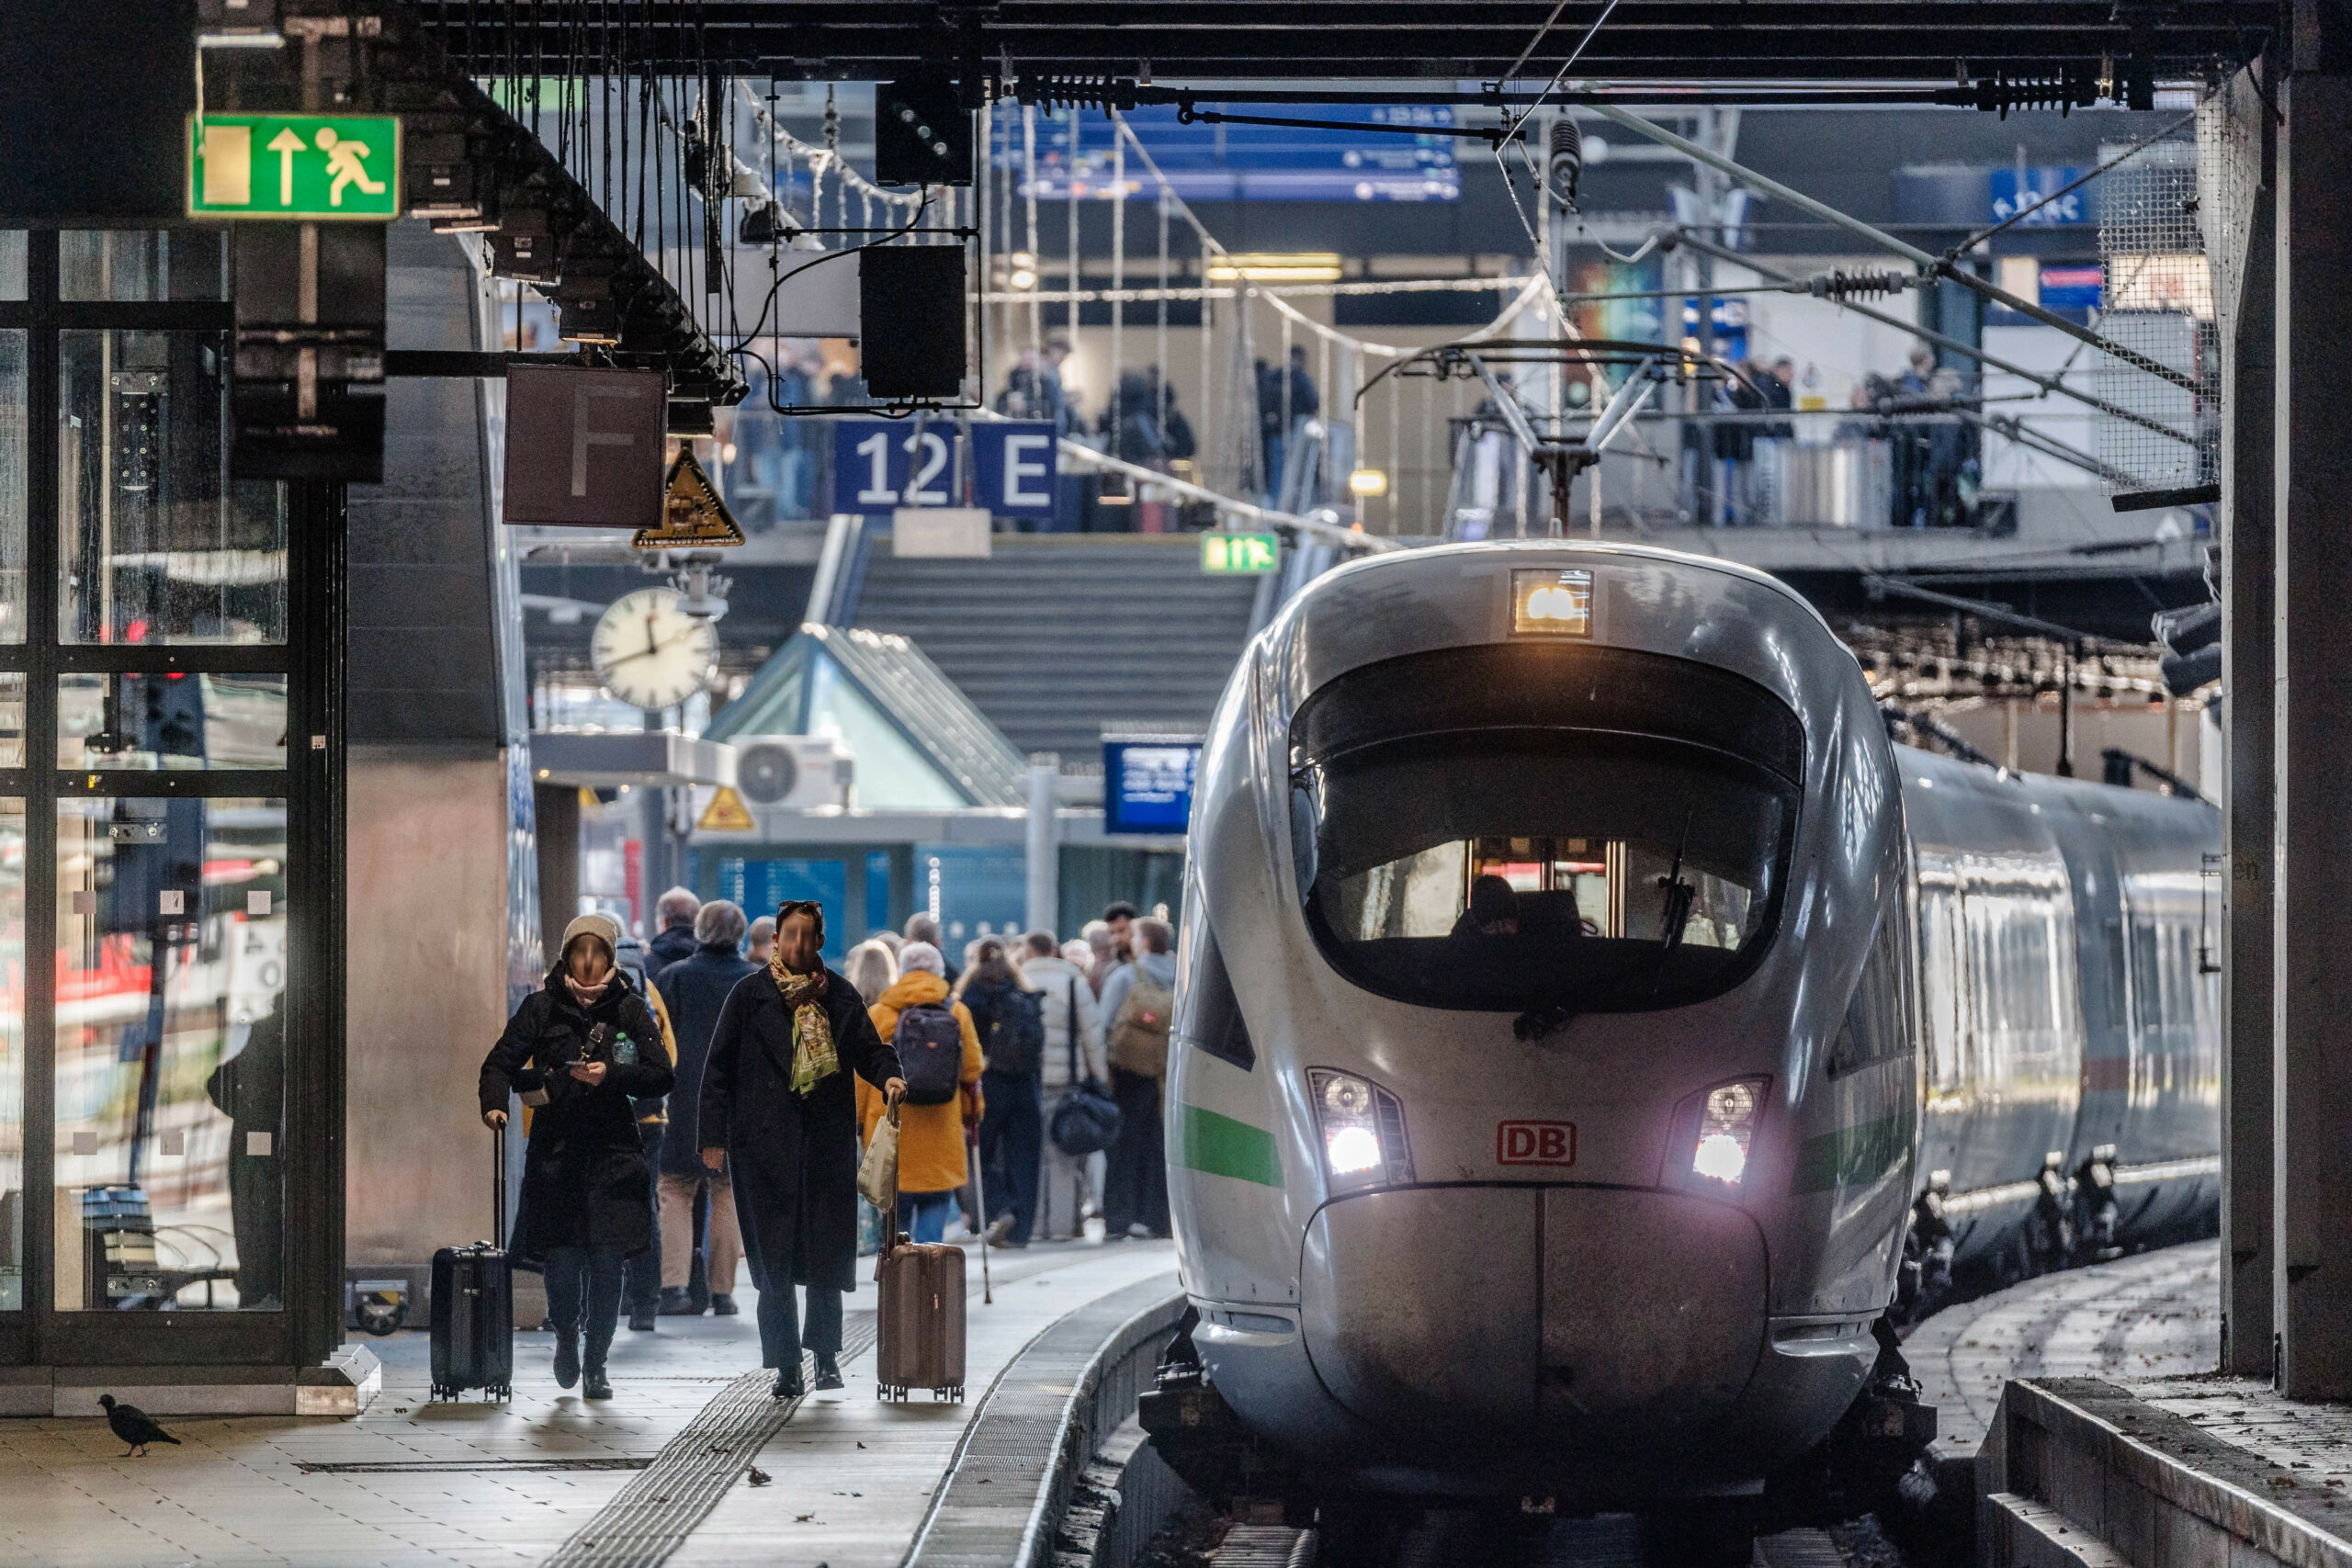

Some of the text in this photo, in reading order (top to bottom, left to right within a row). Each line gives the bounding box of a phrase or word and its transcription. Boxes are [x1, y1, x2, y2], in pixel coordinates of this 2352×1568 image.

[571, 384, 640, 497] F
[855, 432, 948, 505] 12
[1002, 434, 1051, 506] E
[1506, 1125, 1568, 1159] DB
